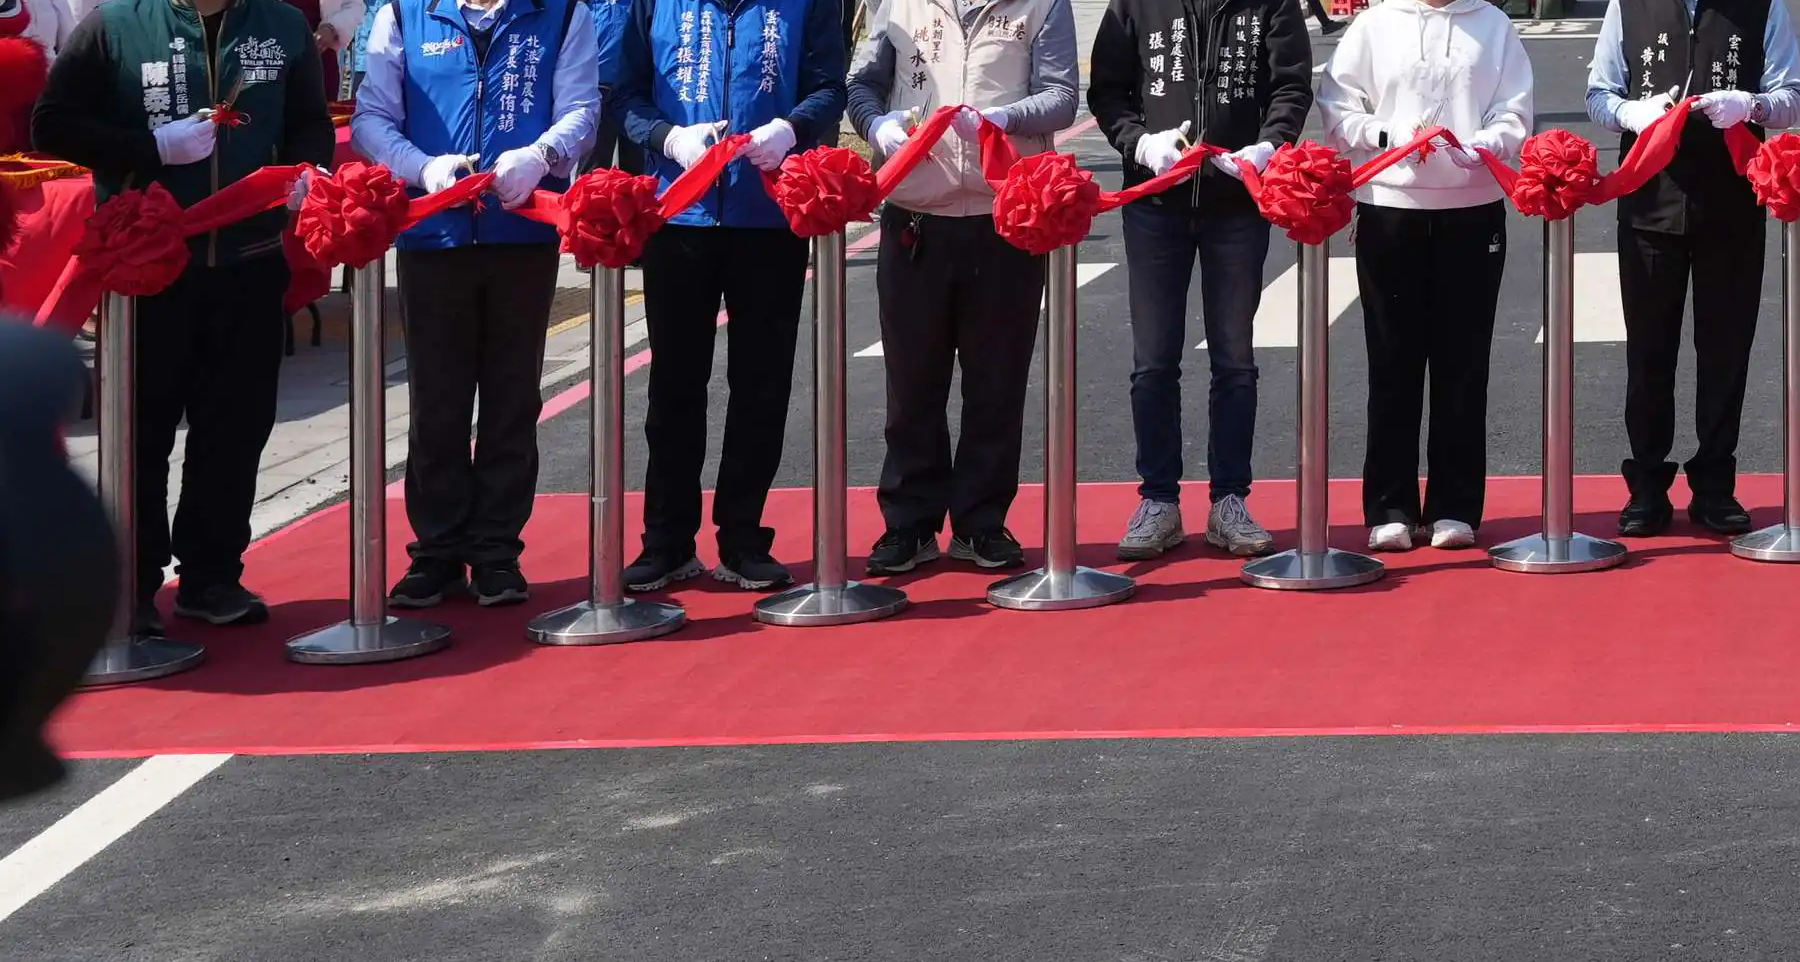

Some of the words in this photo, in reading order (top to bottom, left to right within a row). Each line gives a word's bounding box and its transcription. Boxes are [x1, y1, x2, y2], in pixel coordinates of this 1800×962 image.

[520, 34, 540, 114] 北港鎮農會
[761, 9, 781, 93] 雲林縣政府
[1170, 17, 1186, 82] 服務處主任
[1217, 46, 1232, 104] 服務團隊
[1657, 32, 1669, 62] 議員
